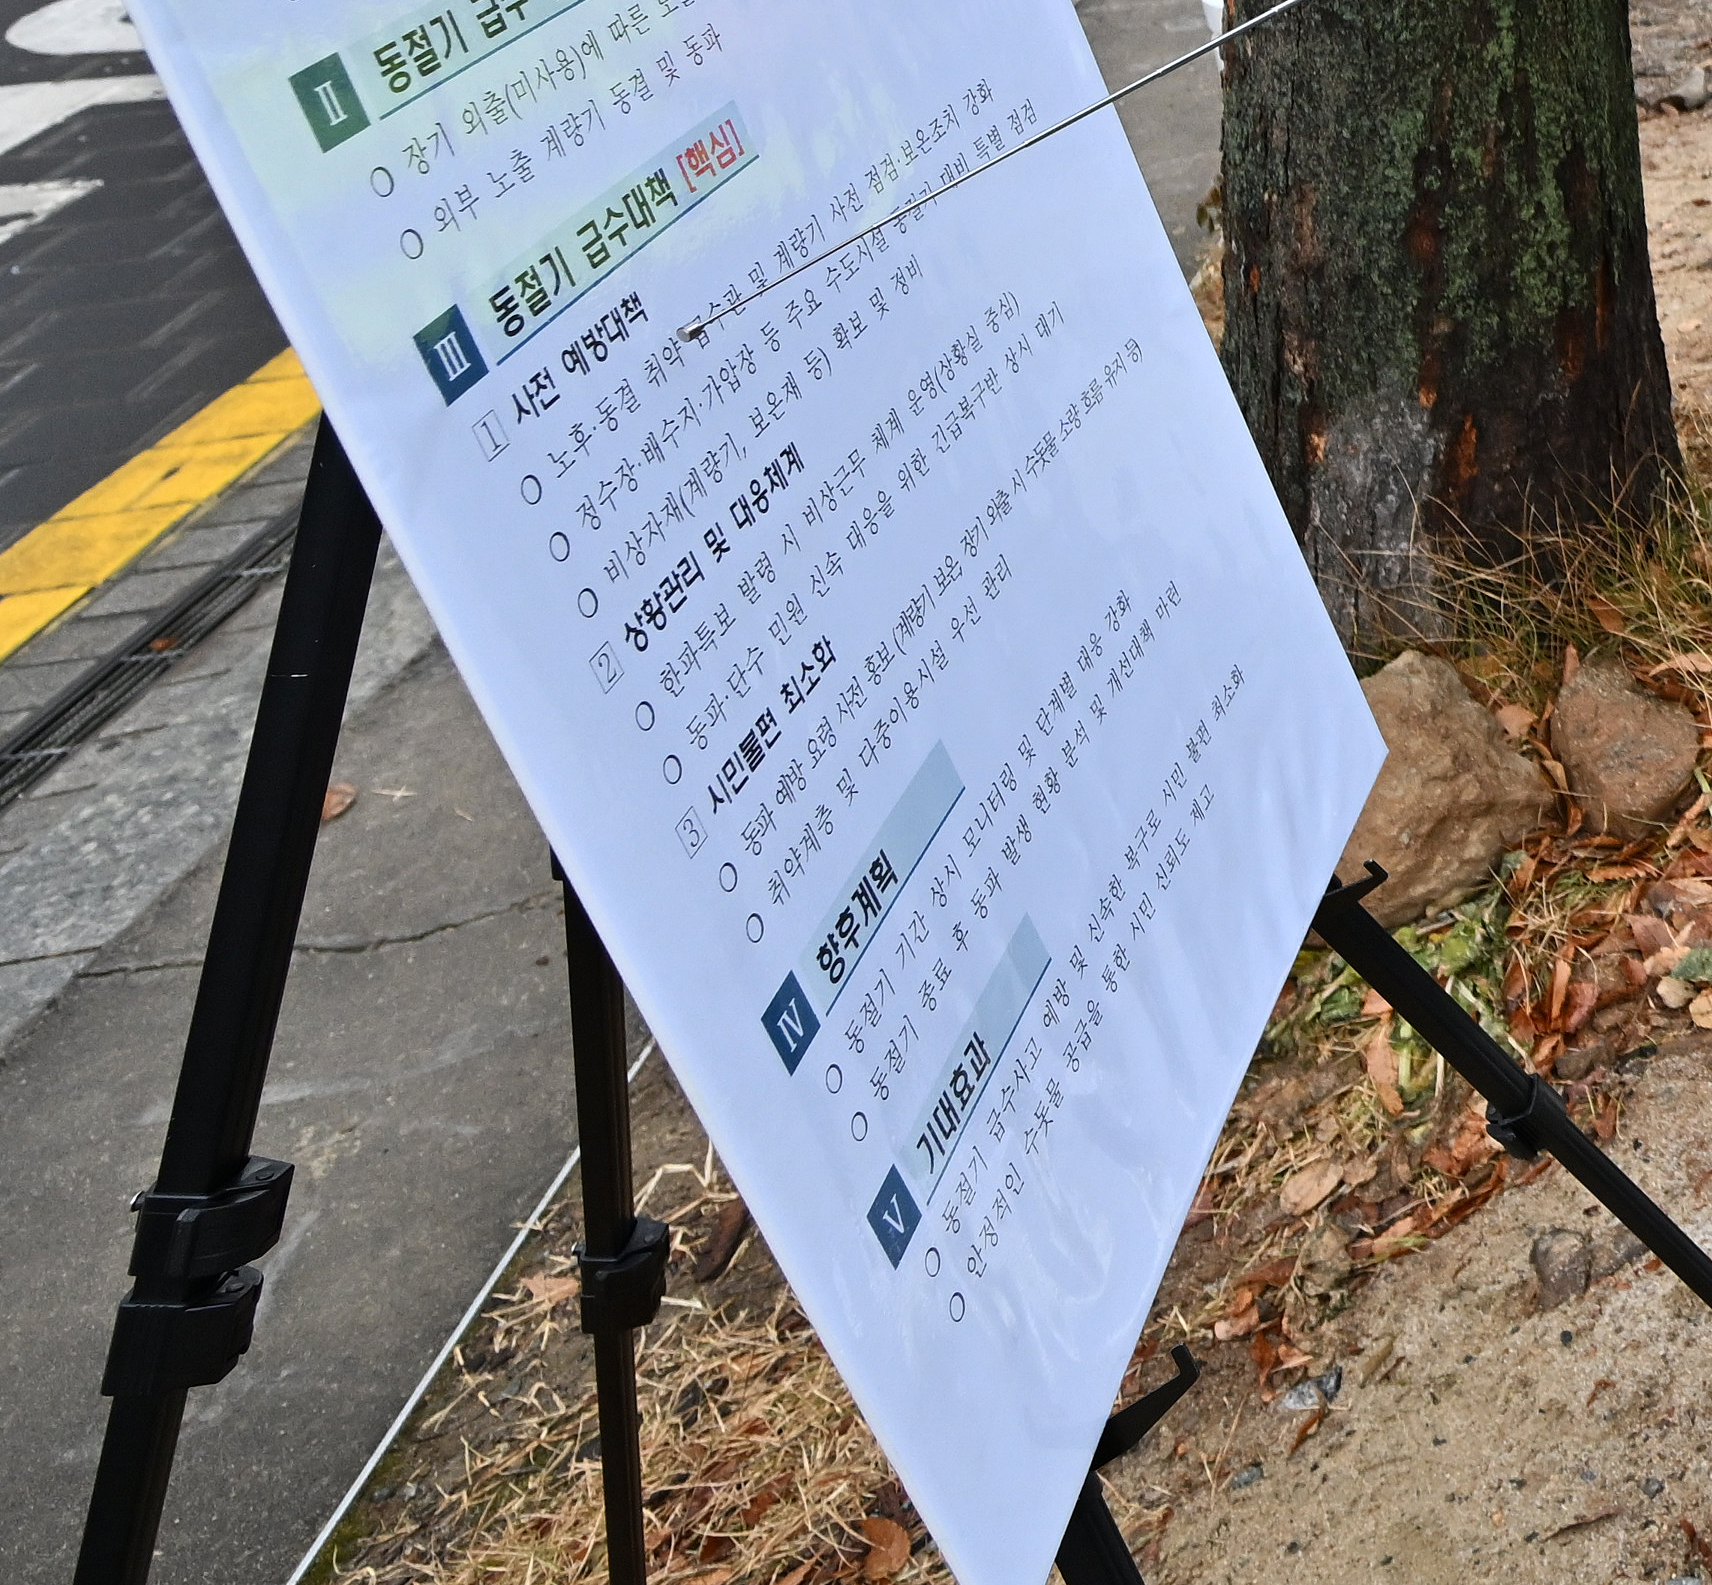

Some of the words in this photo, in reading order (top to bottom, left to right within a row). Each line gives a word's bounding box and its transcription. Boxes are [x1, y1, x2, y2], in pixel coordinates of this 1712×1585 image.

[371, 8, 470, 94] 동절기
[401, 120, 456, 176] 장기
[461, 28, 605, 136] 외출(미사용)에
[606, 2, 651, 44] 따른
[433, 182, 481, 234] 외부
[485, 147, 536, 200] 노출
[539, 98, 607, 161] 계량기
[608, 67, 655, 116] 동결
[655, 49, 681, 89] 및
[682, 21, 723, 67] 동파
[488, 244, 577, 338] 동절기
[575, 166, 680, 271] 급수대책
[674, 118, 746, 194] [핵심]
[479, 418, 502, 453] 1
[511, 365, 562, 426] 사전
[560, 290, 650, 377] 예방대책
[602, 431, 748, 585] 비상자재(계량기,
[747, 369, 803, 439] 보온재
[802, 346, 833, 382] 등)
[831, 309, 869, 350] 확보
[868, 286, 891, 322] 및
[889, 252, 924, 297] 정비
[595, 649, 618, 685] 2
[623, 549, 706, 654] 상황관리
[702, 521, 732, 565] 및
[728, 440, 806, 531] 대응체계
[659, 601, 737, 699] 한파특보
[736, 549, 777, 607] 발령
[780, 522, 802, 556] 시
[801, 447, 867, 528] 비상근무
[870, 406, 906, 455] 체계
[907, 323, 984, 418] 운영(상황실
[983, 290, 1021, 334] 중심)
[685, 645, 765, 752] 동파·단수
[767, 591, 809, 647] 민원
[809, 549, 845, 599] 신속
[845, 489, 896, 552] 대응을
[897, 447, 931, 494] 위한
[930, 366, 1003, 455] 긴급복구반
[1003, 332, 1034, 375] 상시
[1034, 299, 1065, 339] 대기
[680, 813, 702, 850] 3
[706, 706, 783, 816] 시민불편
[779, 634, 838, 715] 최소화
[767, 803, 835, 906] 취약계층
[835, 766, 860, 808] 및
[857, 638, 950, 769] 다중이용시설
[950, 594, 983, 644] 우선
[981, 552, 1013, 601] 관리
[843, 966, 896, 1055] 동절기
[894, 909, 931, 971] 기간
[929, 852, 963, 909] 상시
[961, 760, 1018, 859] 모니터링
[1016, 732, 1038, 769] 및
[1034, 670, 1078, 737] 단계별
[1075, 631, 1104, 673] 대응
[1103, 588, 1133, 634] 강화
[868, 1013, 920, 1102] 동절기
[917, 956, 953, 1013] 종료
[951, 919, 970, 953] 후
[969, 865, 1003, 921] 동파
[1000, 813, 1033, 867] 발생
[1031, 766, 1062, 815] 현황
[1060, 719, 1091, 770] 분석
[1088, 692, 1108, 727] 및
[1106, 617, 1156, 699] 개선대책
[1154, 579, 1183, 621] 마련
[815, 847, 899, 985] 향후계획
[940, 1144, 989, 1235] 동절기
[985, 1035, 1043, 1144] 급수사고
[1042, 979, 1071, 1029] 예방
[1069, 947, 1089, 981] 및
[1088, 876, 1127, 944] 신속한
[1125, 808, 1162, 871] 복구로
[1161, 761, 1188, 808] 시민
[1185, 718, 1213, 764] 불편
[1210, 662, 1246, 723] 최소화
[966, 1160, 1026, 1280] 안정적인
[1023, 1076, 1065, 1157] 수돗물
[1061, 999, 1104, 1074] 공급을
[1100, 942, 1131, 995] 통한
[1129, 890, 1157, 942] 시민
[1154, 826, 1191, 892] 신뢰도
[1189, 782, 1216, 828] 제고
[915, 1030, 992, 1176] 기대효과
